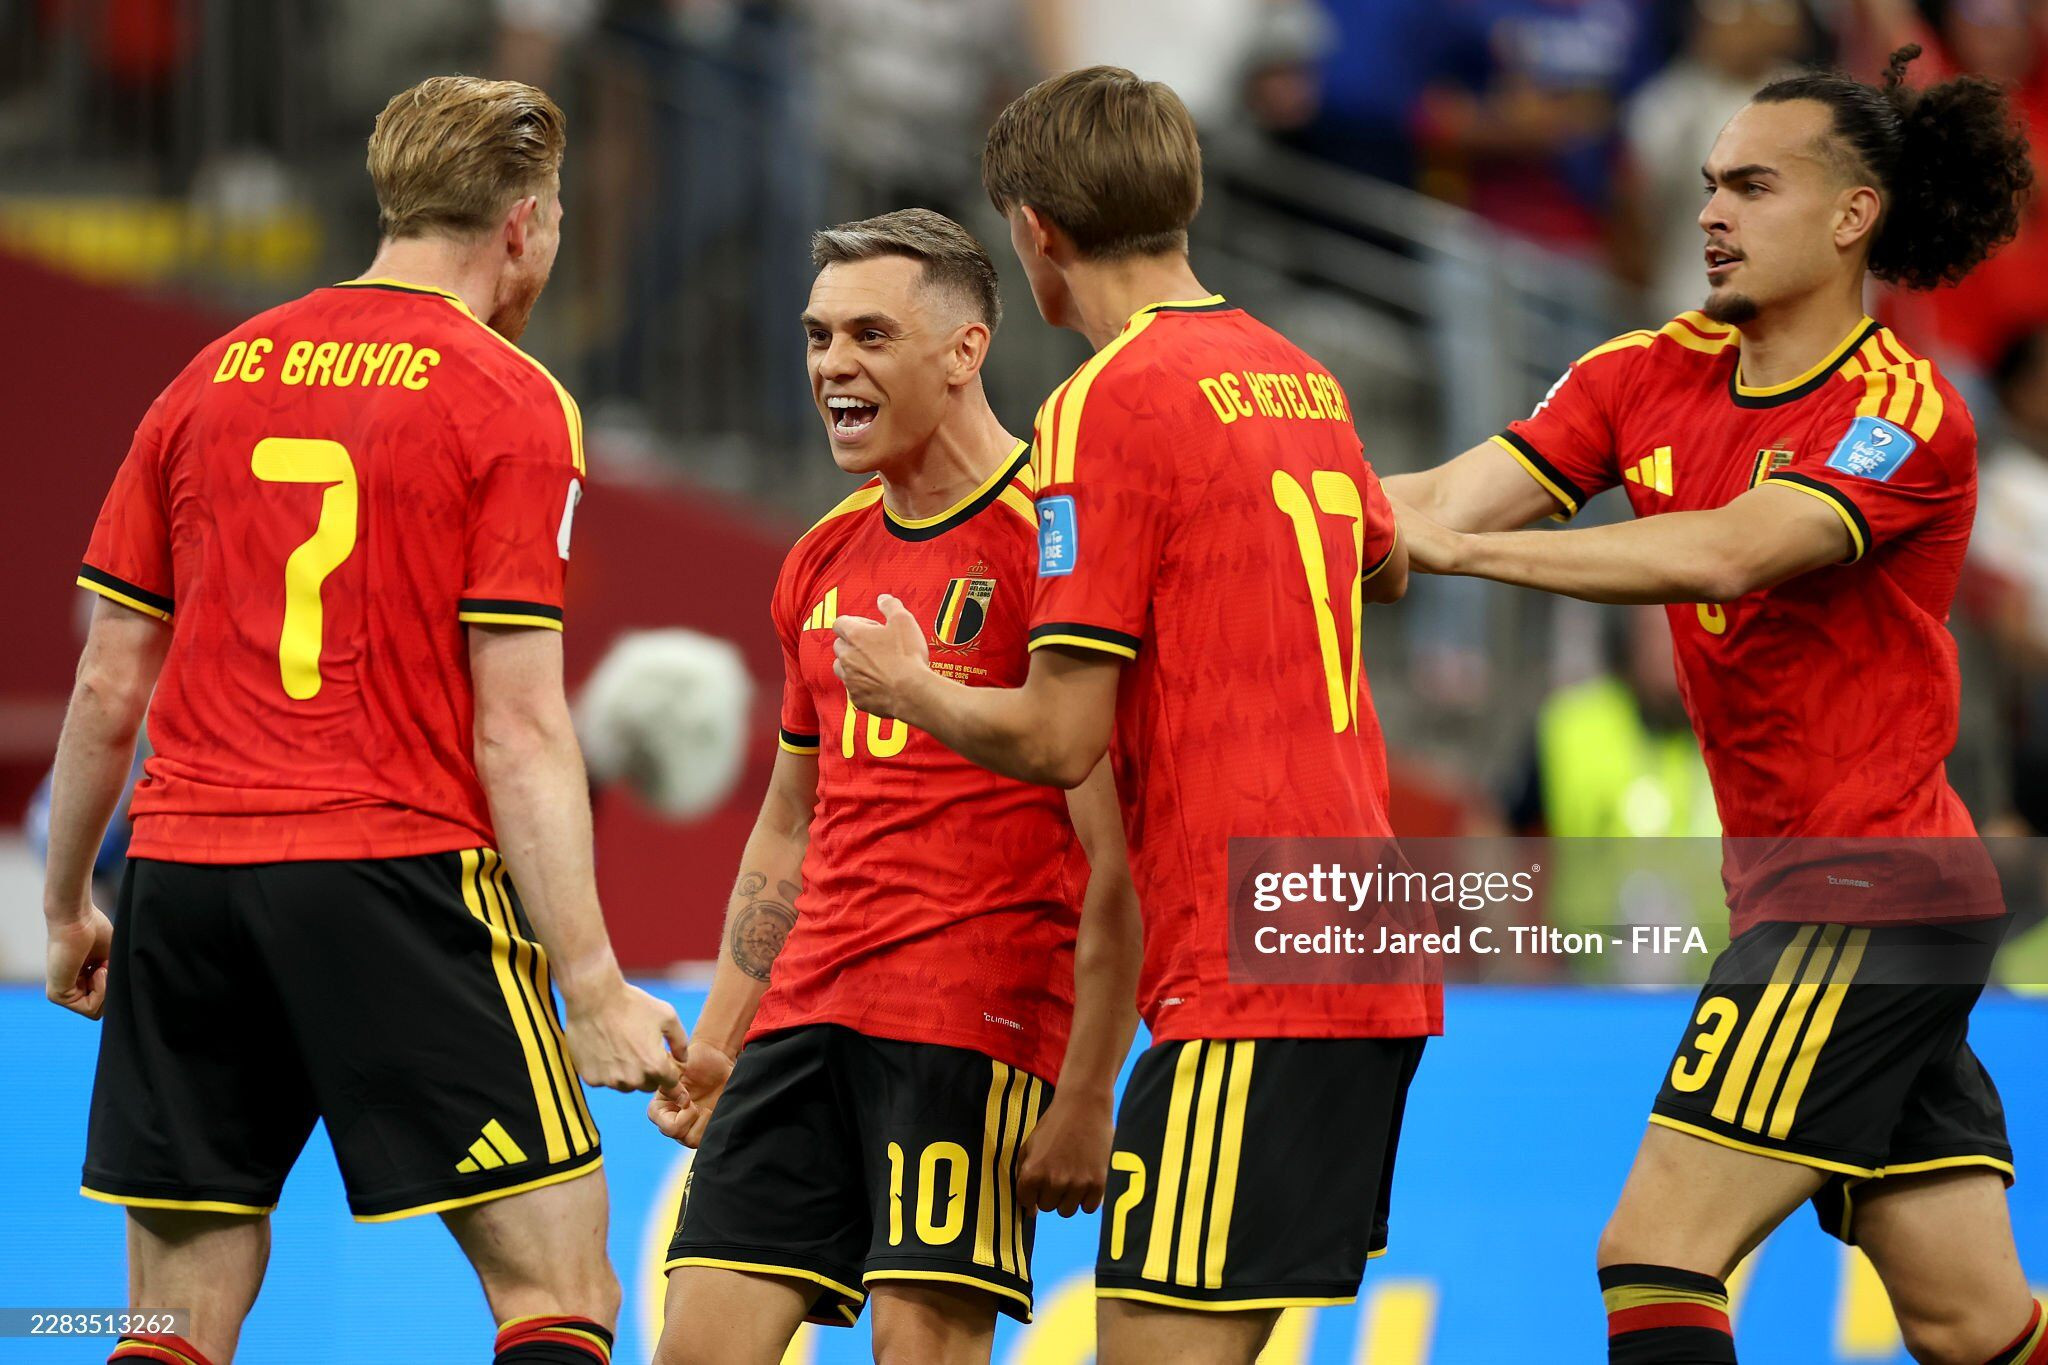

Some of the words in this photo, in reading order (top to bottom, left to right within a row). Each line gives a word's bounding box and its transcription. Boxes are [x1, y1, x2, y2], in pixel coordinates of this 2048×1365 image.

[213, 338, 273, 383] DE
[281, 341, 441, 391] BRUYNE
[1198, 372, 1253, 424] DE
[251, 438, 358, 700] 7
[1272, 470, 1363, 736] 17
[1673, 996, 1739, 1093] 3
[888, 1142, 970, 1246] 10
